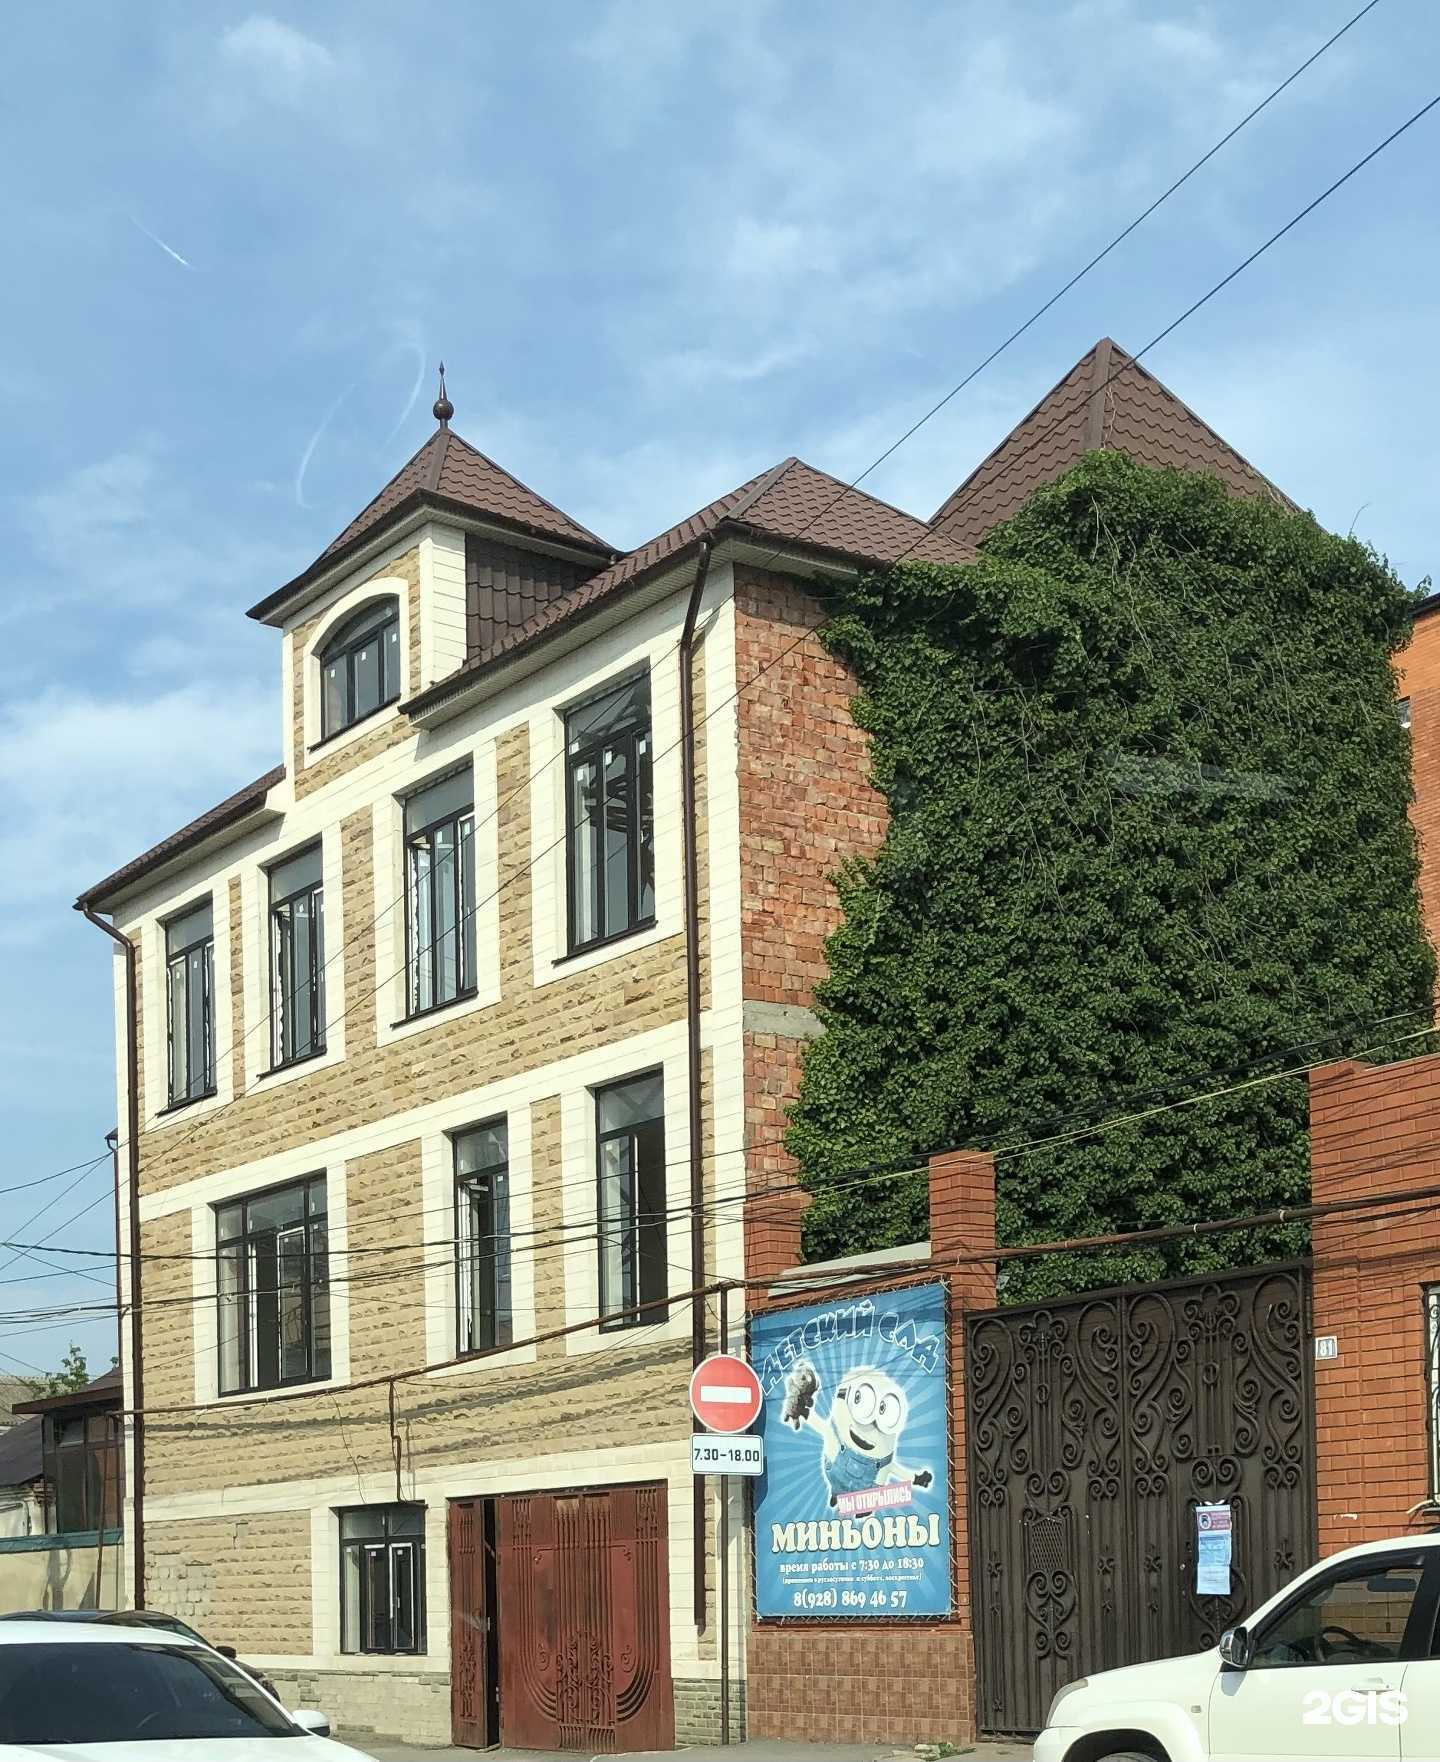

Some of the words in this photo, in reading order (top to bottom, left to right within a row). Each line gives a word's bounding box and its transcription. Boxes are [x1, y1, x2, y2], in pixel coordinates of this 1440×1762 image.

[760, 1298, 876, 1396] ДЕТСКИЙ
[878, 1311, 940, 1374] САД
[693, 1448, 760, 1462] 7.30-18.00
[855, 1486, 912, 1510] ОТКРЫЛИСЬ
[770, 1513, 941, 1554] МИНЬОНЫ
[779, 1563, 809, 1574] время
[811, 1557, 848, 1573] работы
[851, 1562, 857, 1570] с
[859, 1559, 880, 1570] 7:30
[882, 1559, 895, 1570] до
[897, 1557, 924, 1570] 18:30
[793, 1587, 837, 1608] 8(928)
[841, 1590, 866, 1608] 869
[869, 1590, 887, 1607] 46
[890, 1590, 907, 1608] 57
